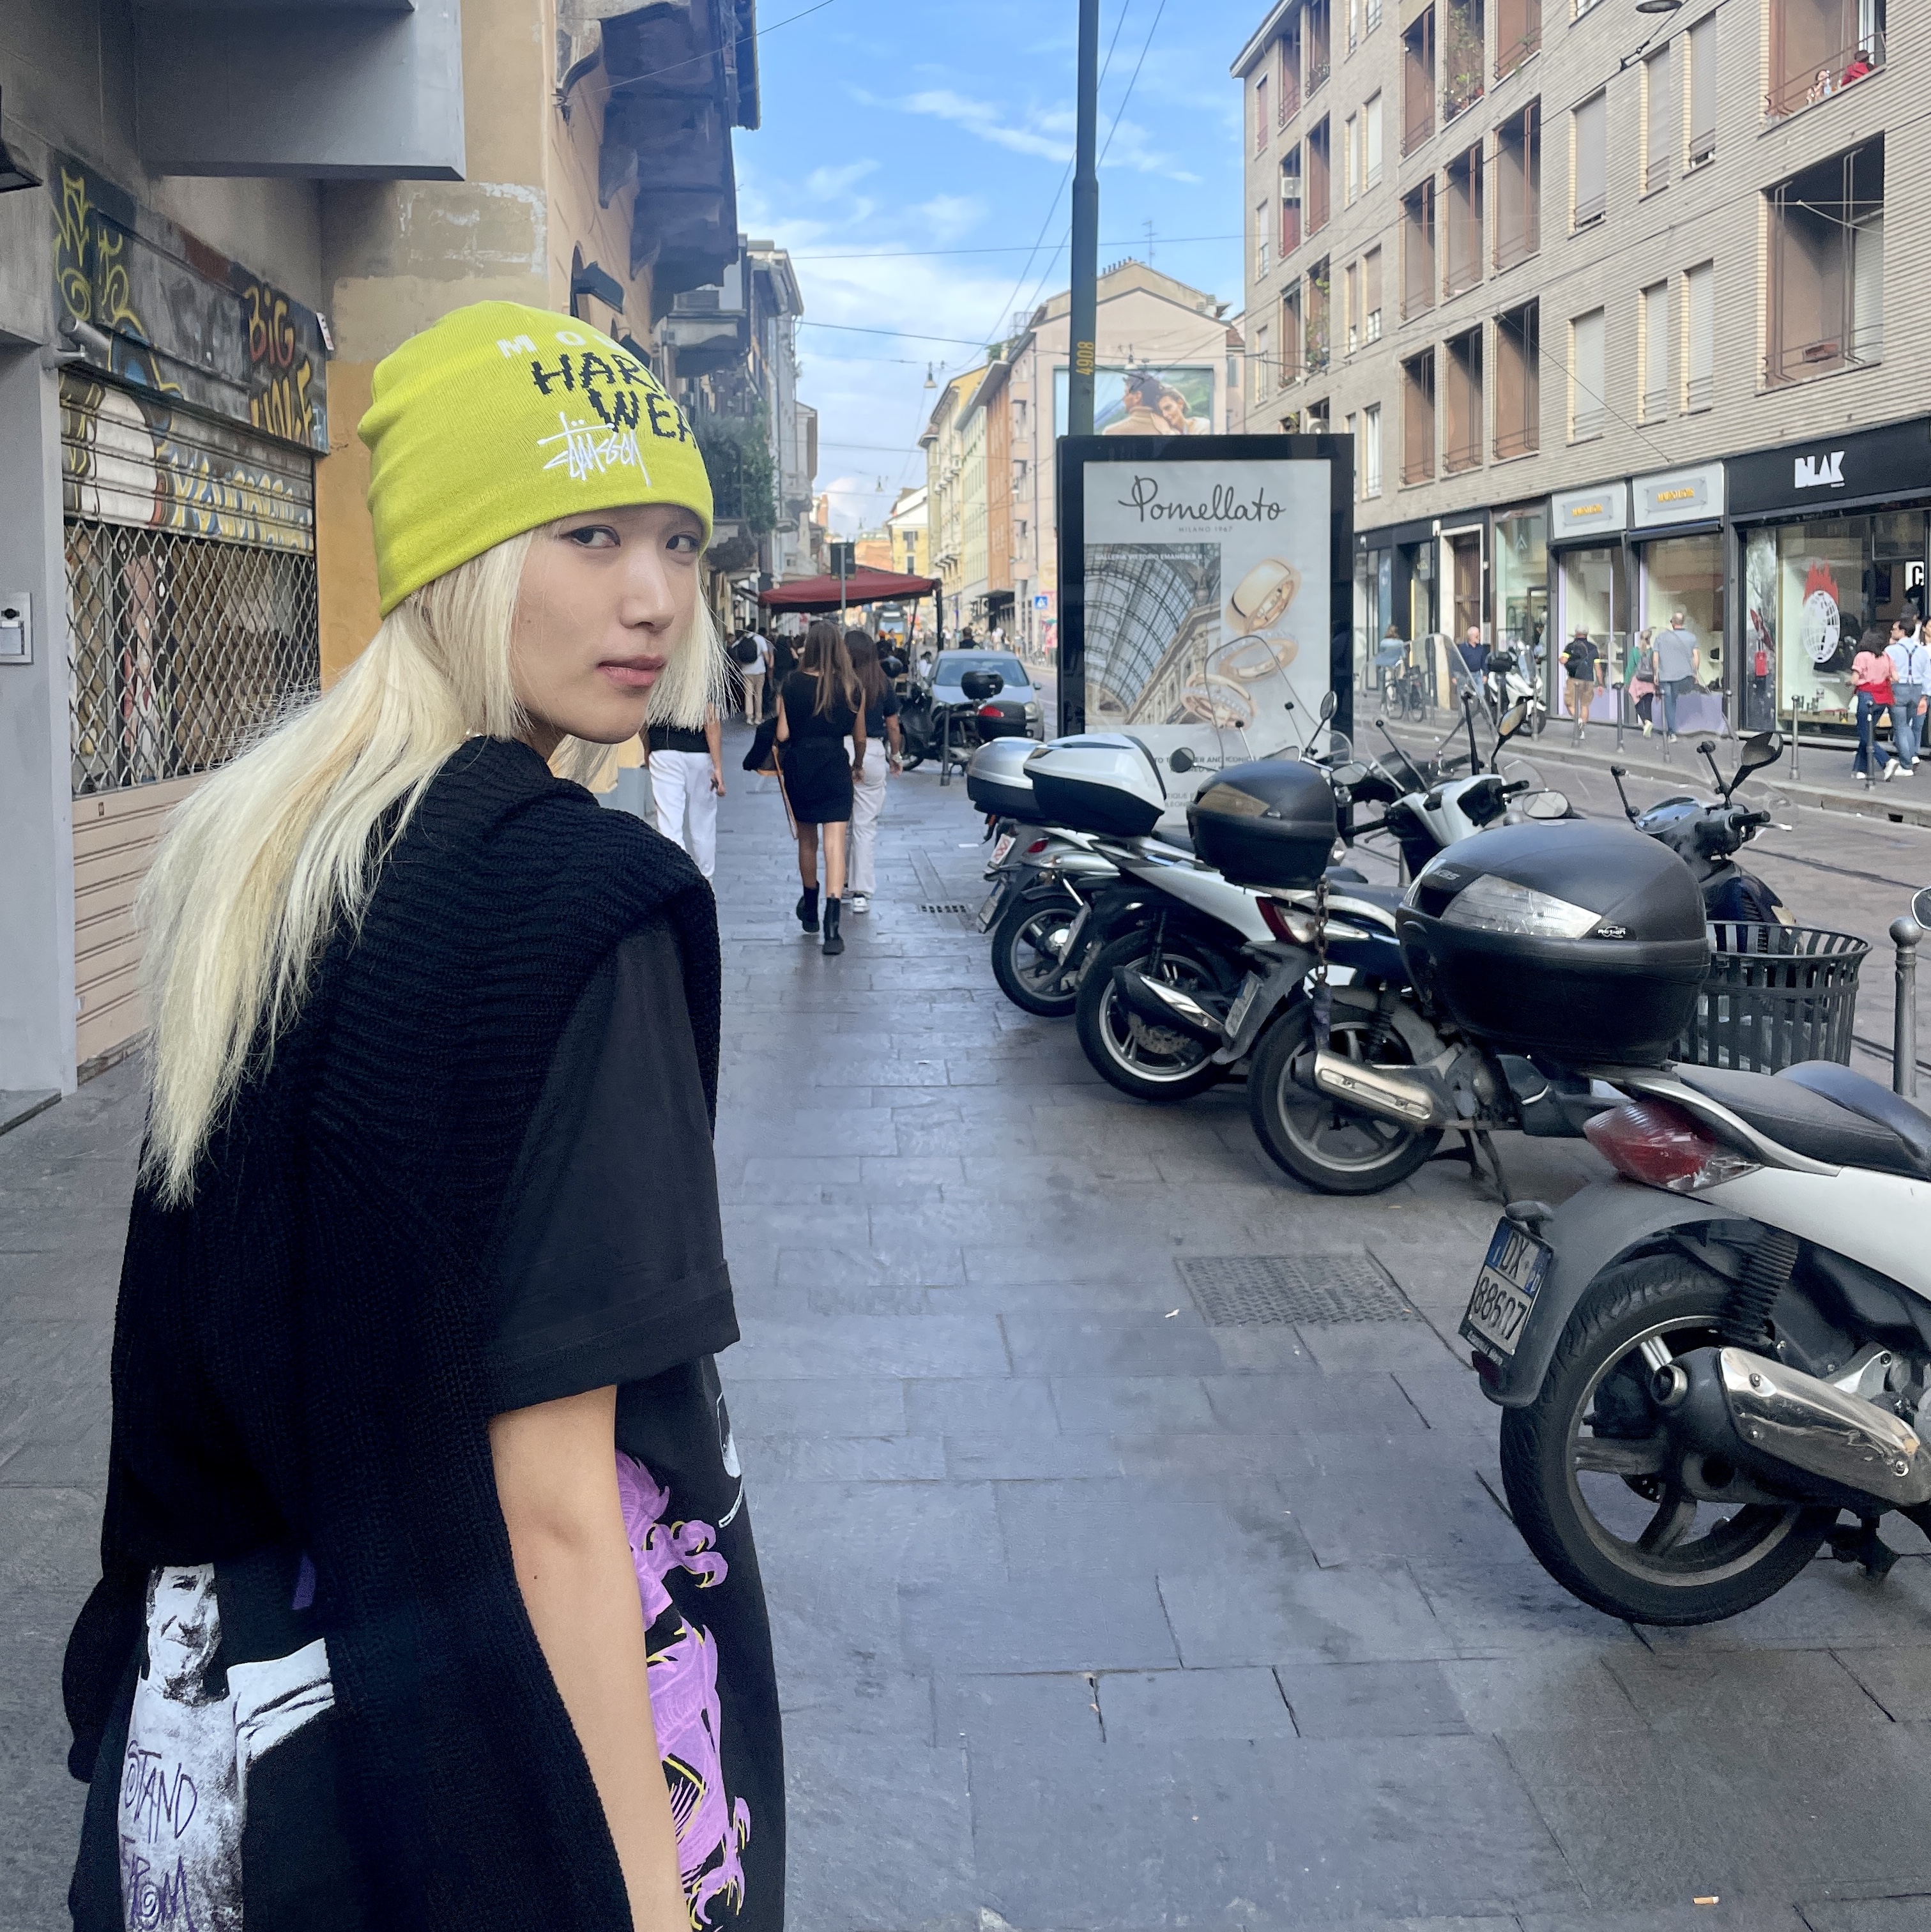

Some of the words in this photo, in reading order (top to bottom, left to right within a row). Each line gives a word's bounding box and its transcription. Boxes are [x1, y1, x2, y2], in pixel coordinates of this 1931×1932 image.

[1076, 341, 1094, 375] 4908
[1118, 475, 1286, 522] Pomellato
[1501, 1231, 1530, 1279] DX
